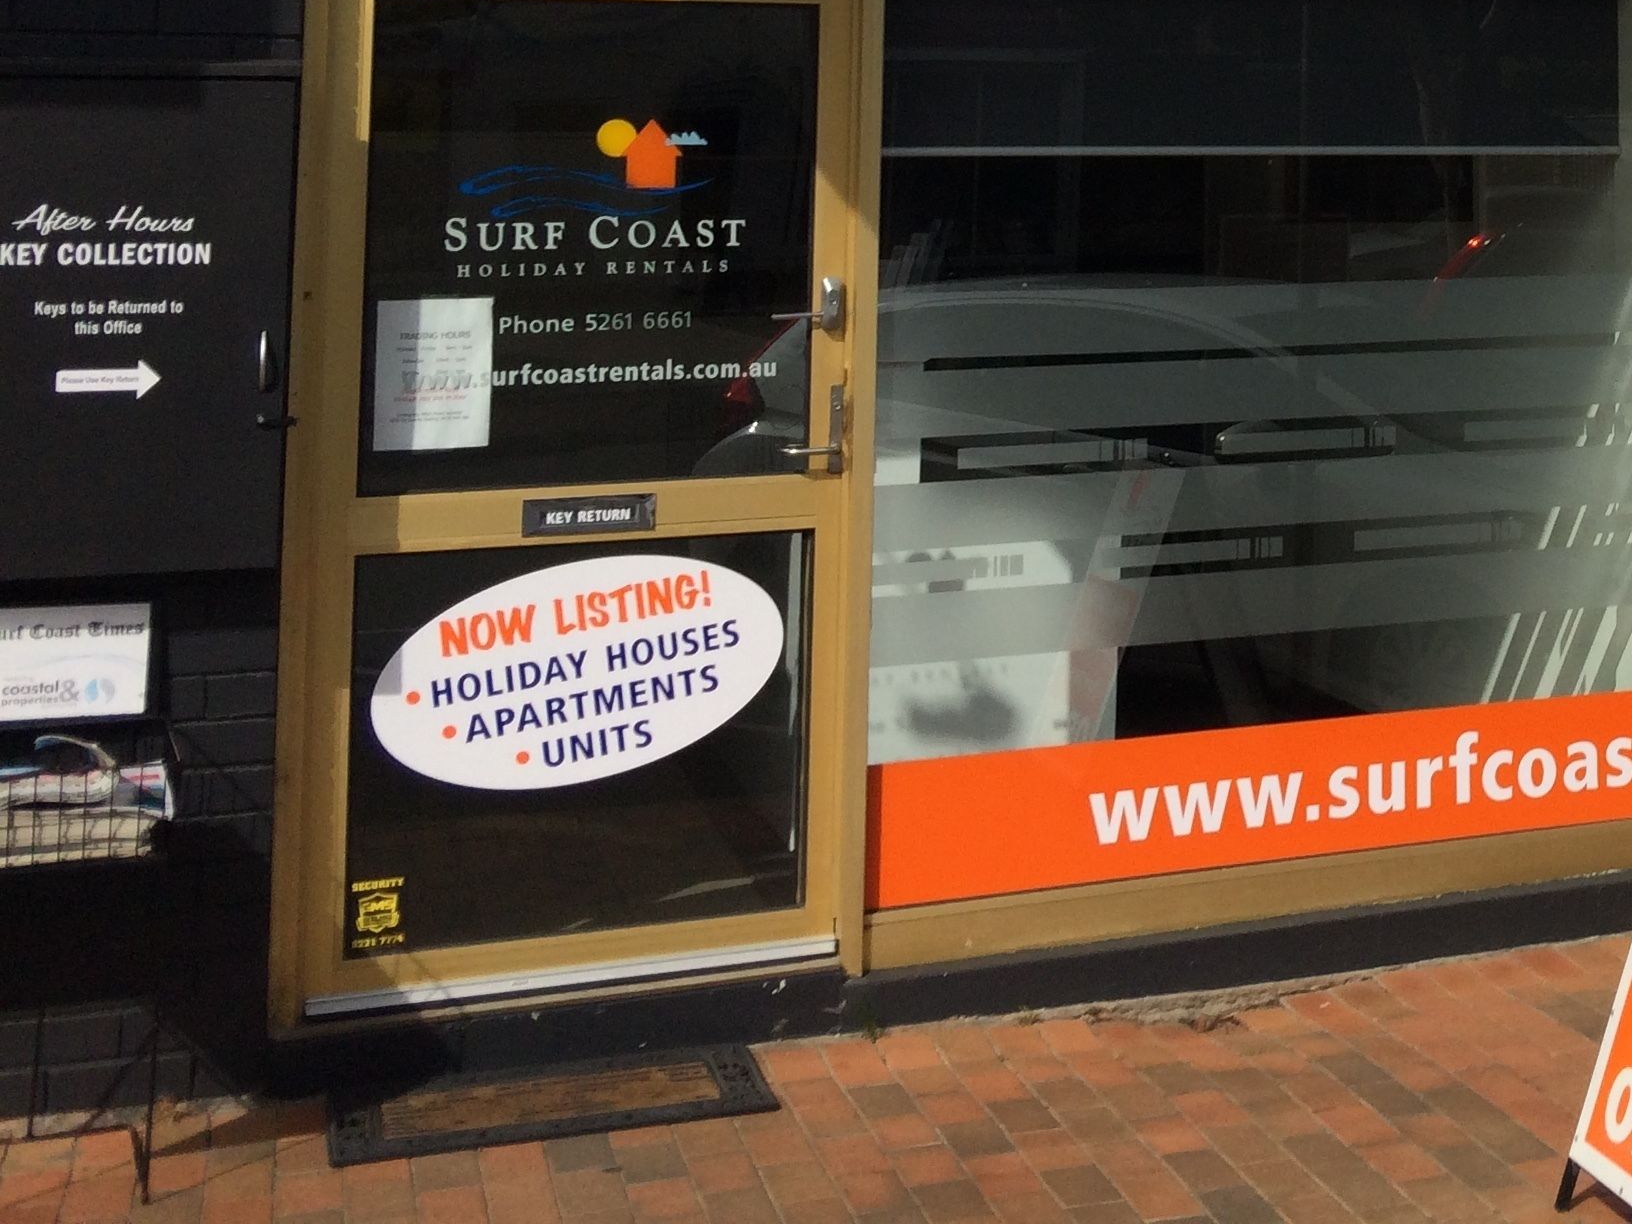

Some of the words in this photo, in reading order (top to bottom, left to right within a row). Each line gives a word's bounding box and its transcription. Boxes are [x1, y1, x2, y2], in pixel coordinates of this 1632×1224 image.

[11, 204, 96, 235] After
[105, 205, 195, 232] Hours
[444, 217, 565, 252] SURF
[589, 215, 746, 249] COAST
[0, 243, 48, 266] KEY
[57, 242, 212, 265] COLLECTION
[457, 262, 586, 278] HOLIDAY
[607, 260, 729, 275] RENTALS
[34, 301, 66, 318] Keys
[71, 301, 84, 314] to
[88, 301, 104, 314] be
[108, 299, 167, 314] Returned
[170, 300, 184, 314] to
[74, 321, 99, 335] this
[103, 320, 143, 335] Office
[499, 316, 574, 334] Phone
[586, 313, 633, 331] 5261
[643, 311, 692, 329] 6661
[546, 510, 574, 525] KEY
[577, 507, 631, 523] RETURN
[439, 605, 536, 657] NOW
[554, 570, 712, 635] LISTING!
[29, 623, 80, 640] Coast
[88, 620, 145, 637] Times
[431, 650, 588, 708] HOLIDAY
[607, 619, 739, 671] HOUSES
[2, 680, 59, 695] coastal
[1, 695, 58, 706] properties
[466, 665, 719, 743] APARTMENTS
[542, 719, 653, 767] UNITS
[352, 877, 404, 892] SECURITY
